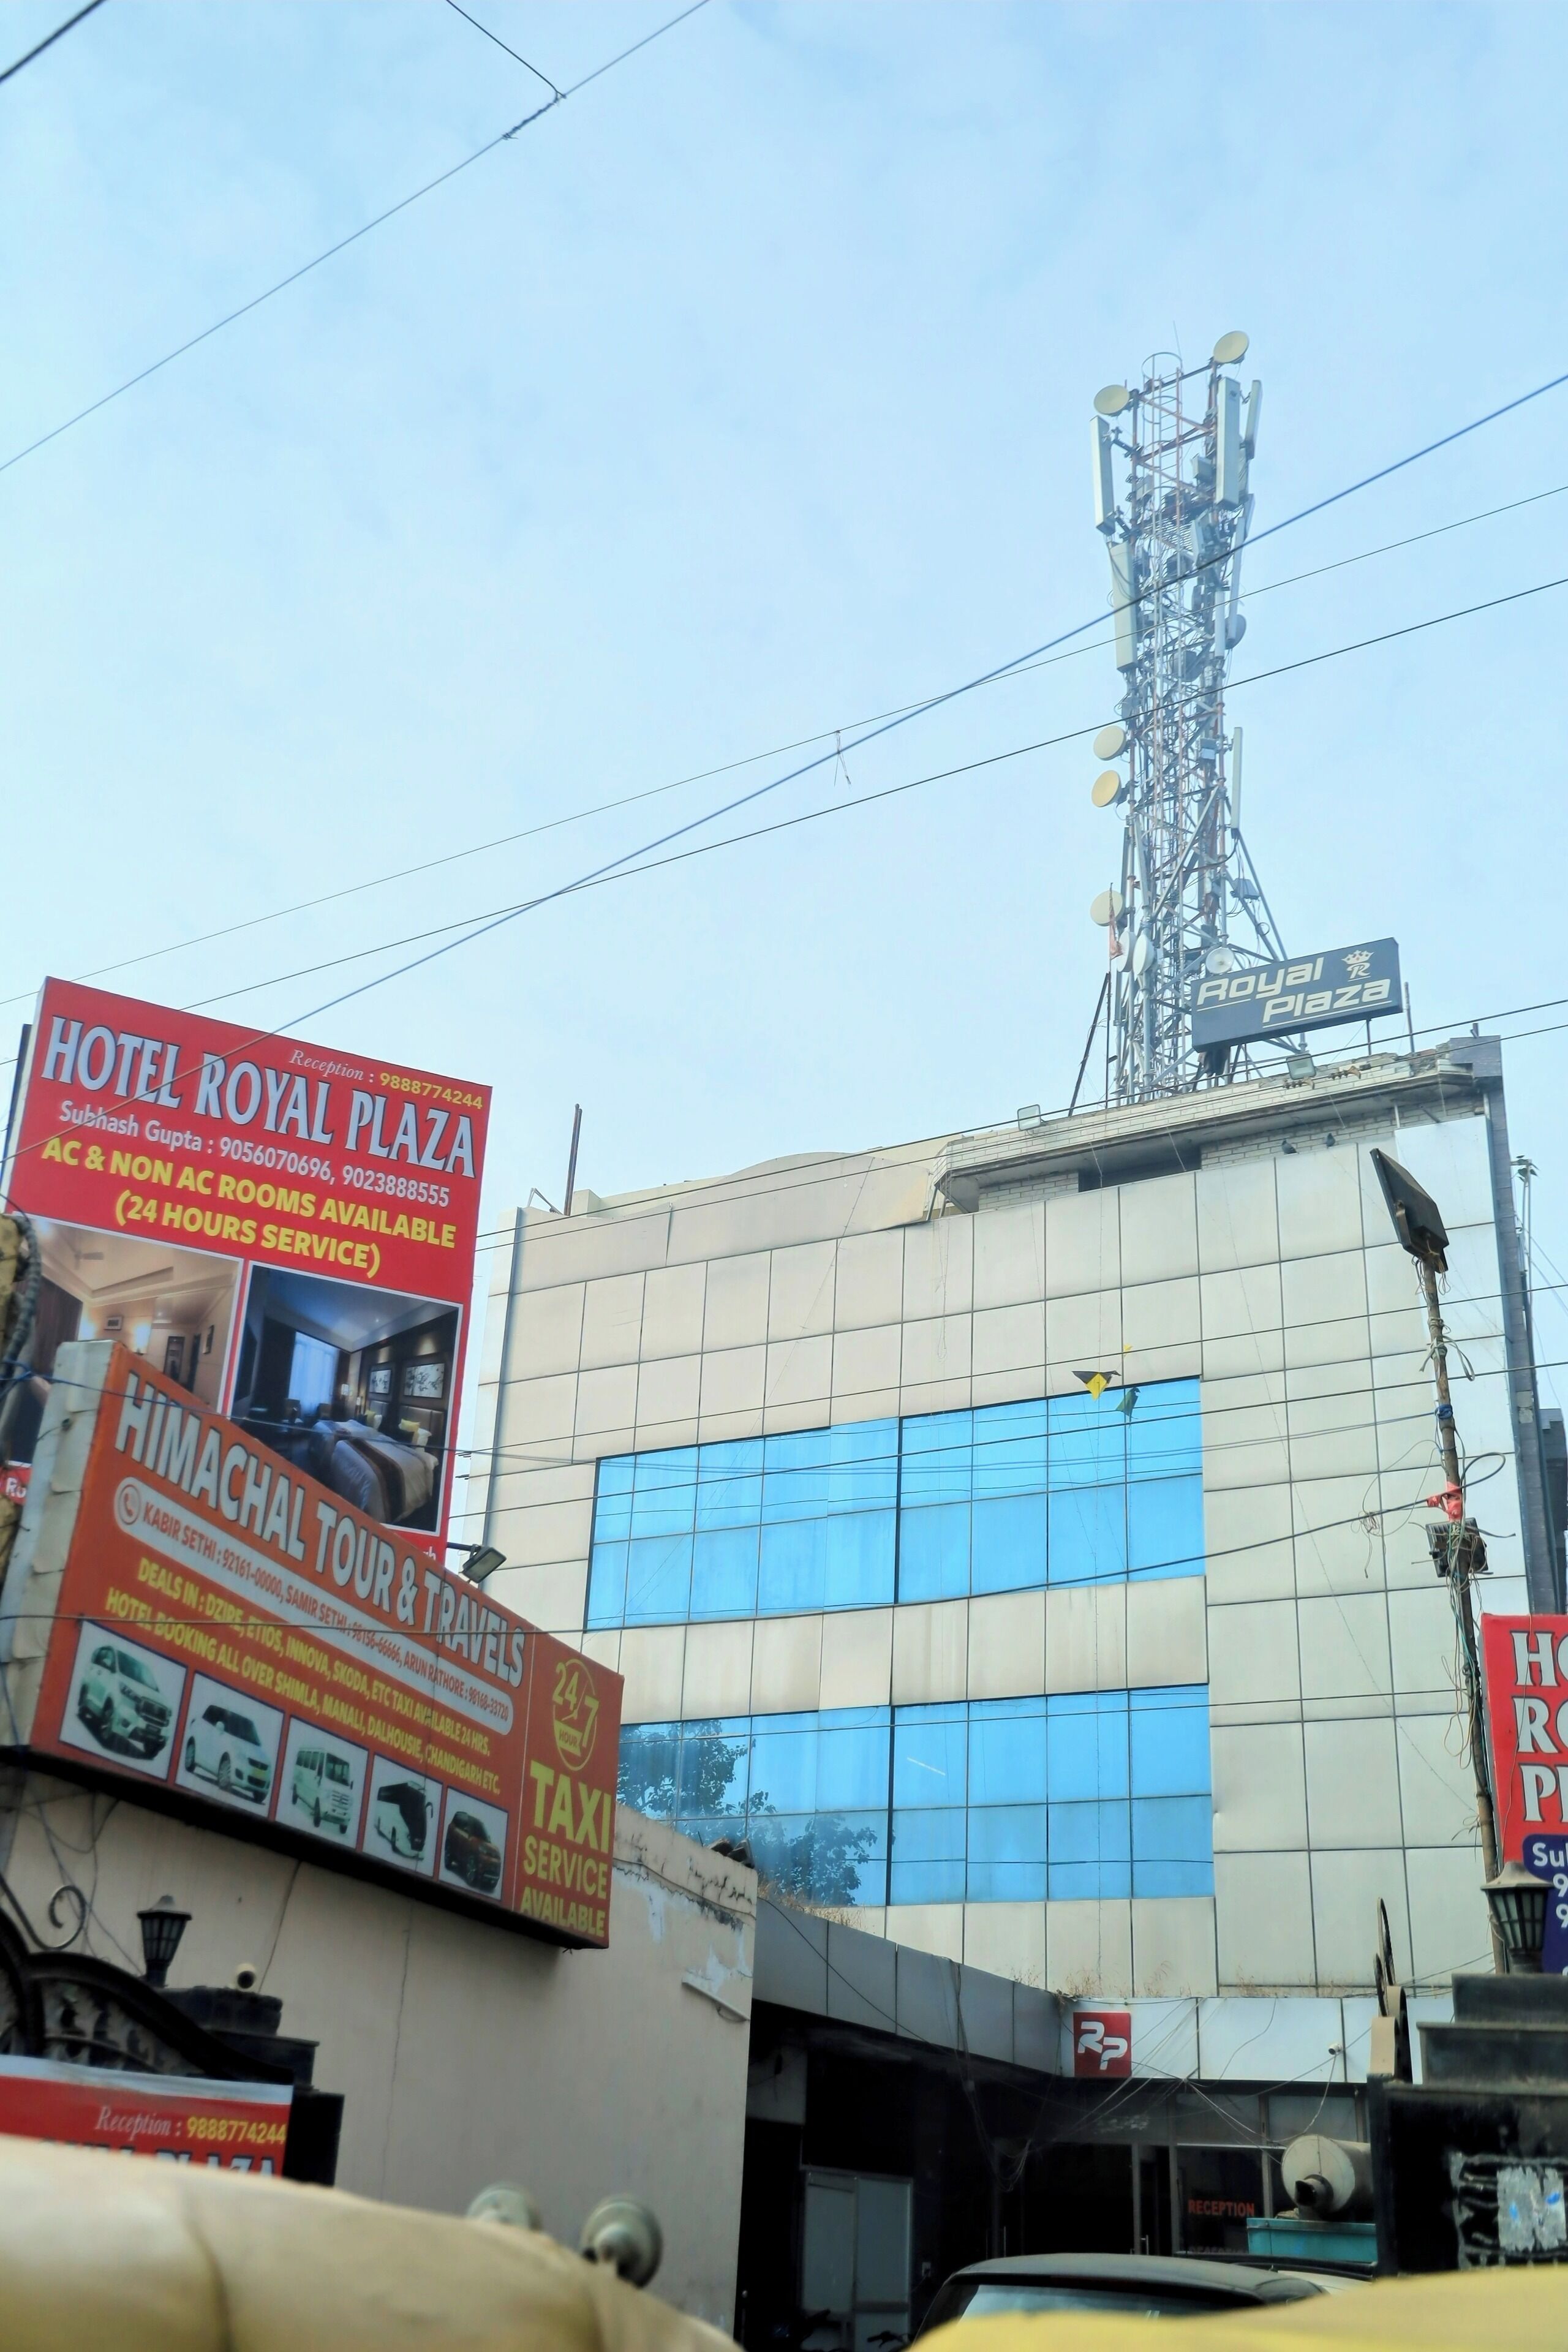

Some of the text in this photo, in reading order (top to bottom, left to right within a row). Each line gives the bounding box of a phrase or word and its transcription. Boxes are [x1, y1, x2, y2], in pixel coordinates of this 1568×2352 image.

[1197, 957, 1324, 1005] Royal
[1262, 978, 1391, 1023] Plaza
[40, 1016, 475, 1178] HOTEL ROYAL PLAZA
[289, 1049, 364, 1080] Reception
[380, 1072, 483, 1109] 9888774244
[41, 1137, 457, 1248] AC & NON AC ROOMS AVAILABLE
[59, 1100, 138, 1137] Subhash
[145, 1120, 202, 1152] Gupta
[220, 1136, 335, 1185] 9056070696,
[342, 1165, 450, 1208] 9023888555
[115, 1189, 380, 1279] (24 HOURS SERVICE)
[115, 1370, 525, 1688] HIMACHAL TOUR & TRAVELS
[143, 1502, 181, 1541] KABIR
[182, 1525, 217, 1561] SETHI
[285, 1585, 318, 1618] SAMIR
[403, 1651, 428, 1679] ARUN
[105, 1586, 153, 1631] HOTEL
[154, 1611, 217, 1662] BOOKING
[216, 1644, 239, 1673] ALL
[241, 1655, 274, 1689] OVER
[425, 1744, 483, 1787] CHANDIGARH
[138, 1556, 183, 1600] DEALS
[183, 1581, 200, 1608] IN
[371, 1679, 392, 1707] ETC
[392, 1690, 414, 1718] TAXI
[413, 1702, 461, 1741] AVAILABLE
[530, 1760, 611, 1854] TAXI
[523, 1834, 608, 1900] SERVICE
[519, 1887, 606, 1939] AVAILABLE
[1078, 2021, 1128, 2070] RP
[96, 2105, 172, 2141] Reception
[187, 2116, 286, 2144] 9888774244
[1188, 2199, 1255, 2217] RECEPTION
